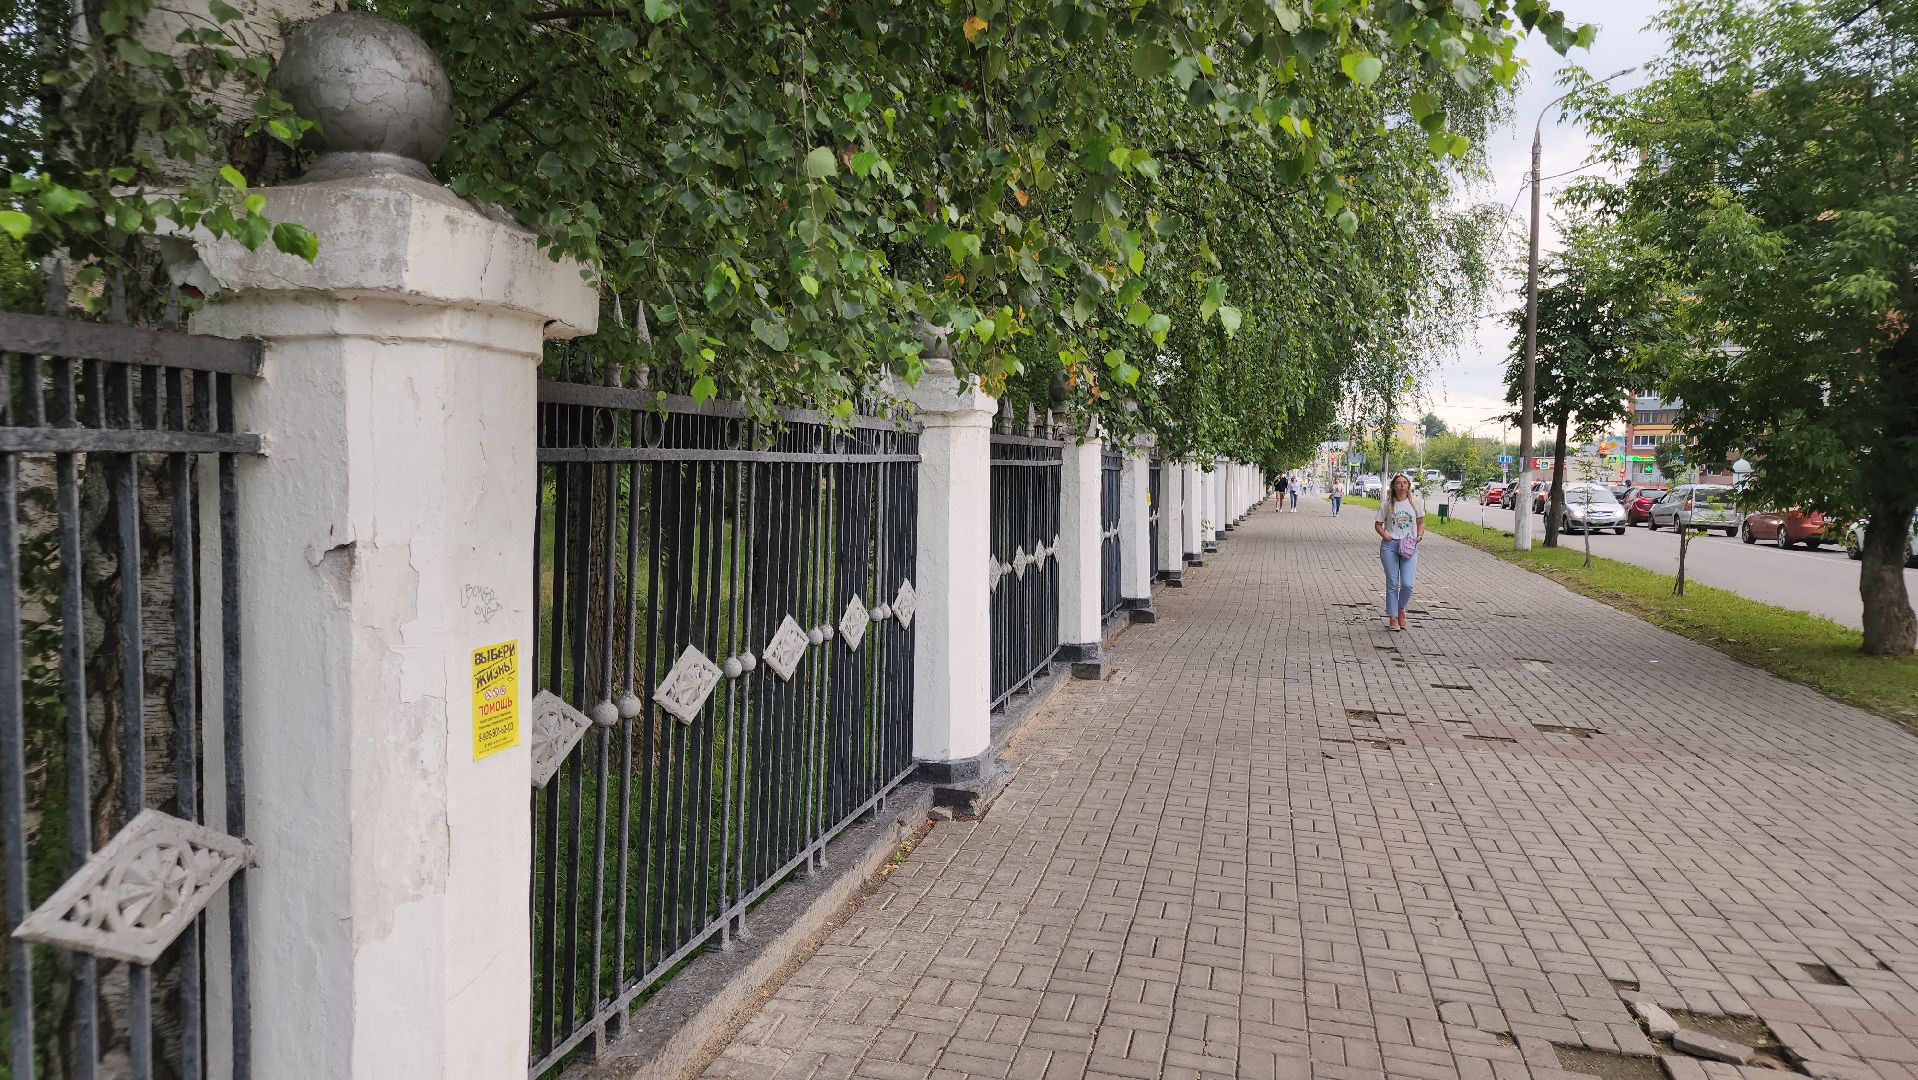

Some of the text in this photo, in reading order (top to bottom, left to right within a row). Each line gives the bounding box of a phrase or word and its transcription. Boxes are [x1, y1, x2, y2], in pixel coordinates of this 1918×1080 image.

[474, 643, 515, 666] ВЫБЕРИ
[475, 657, 513, 689] ЖИЗНЬ!
[479, 697, 513, 717] ПОМОЩЬ
